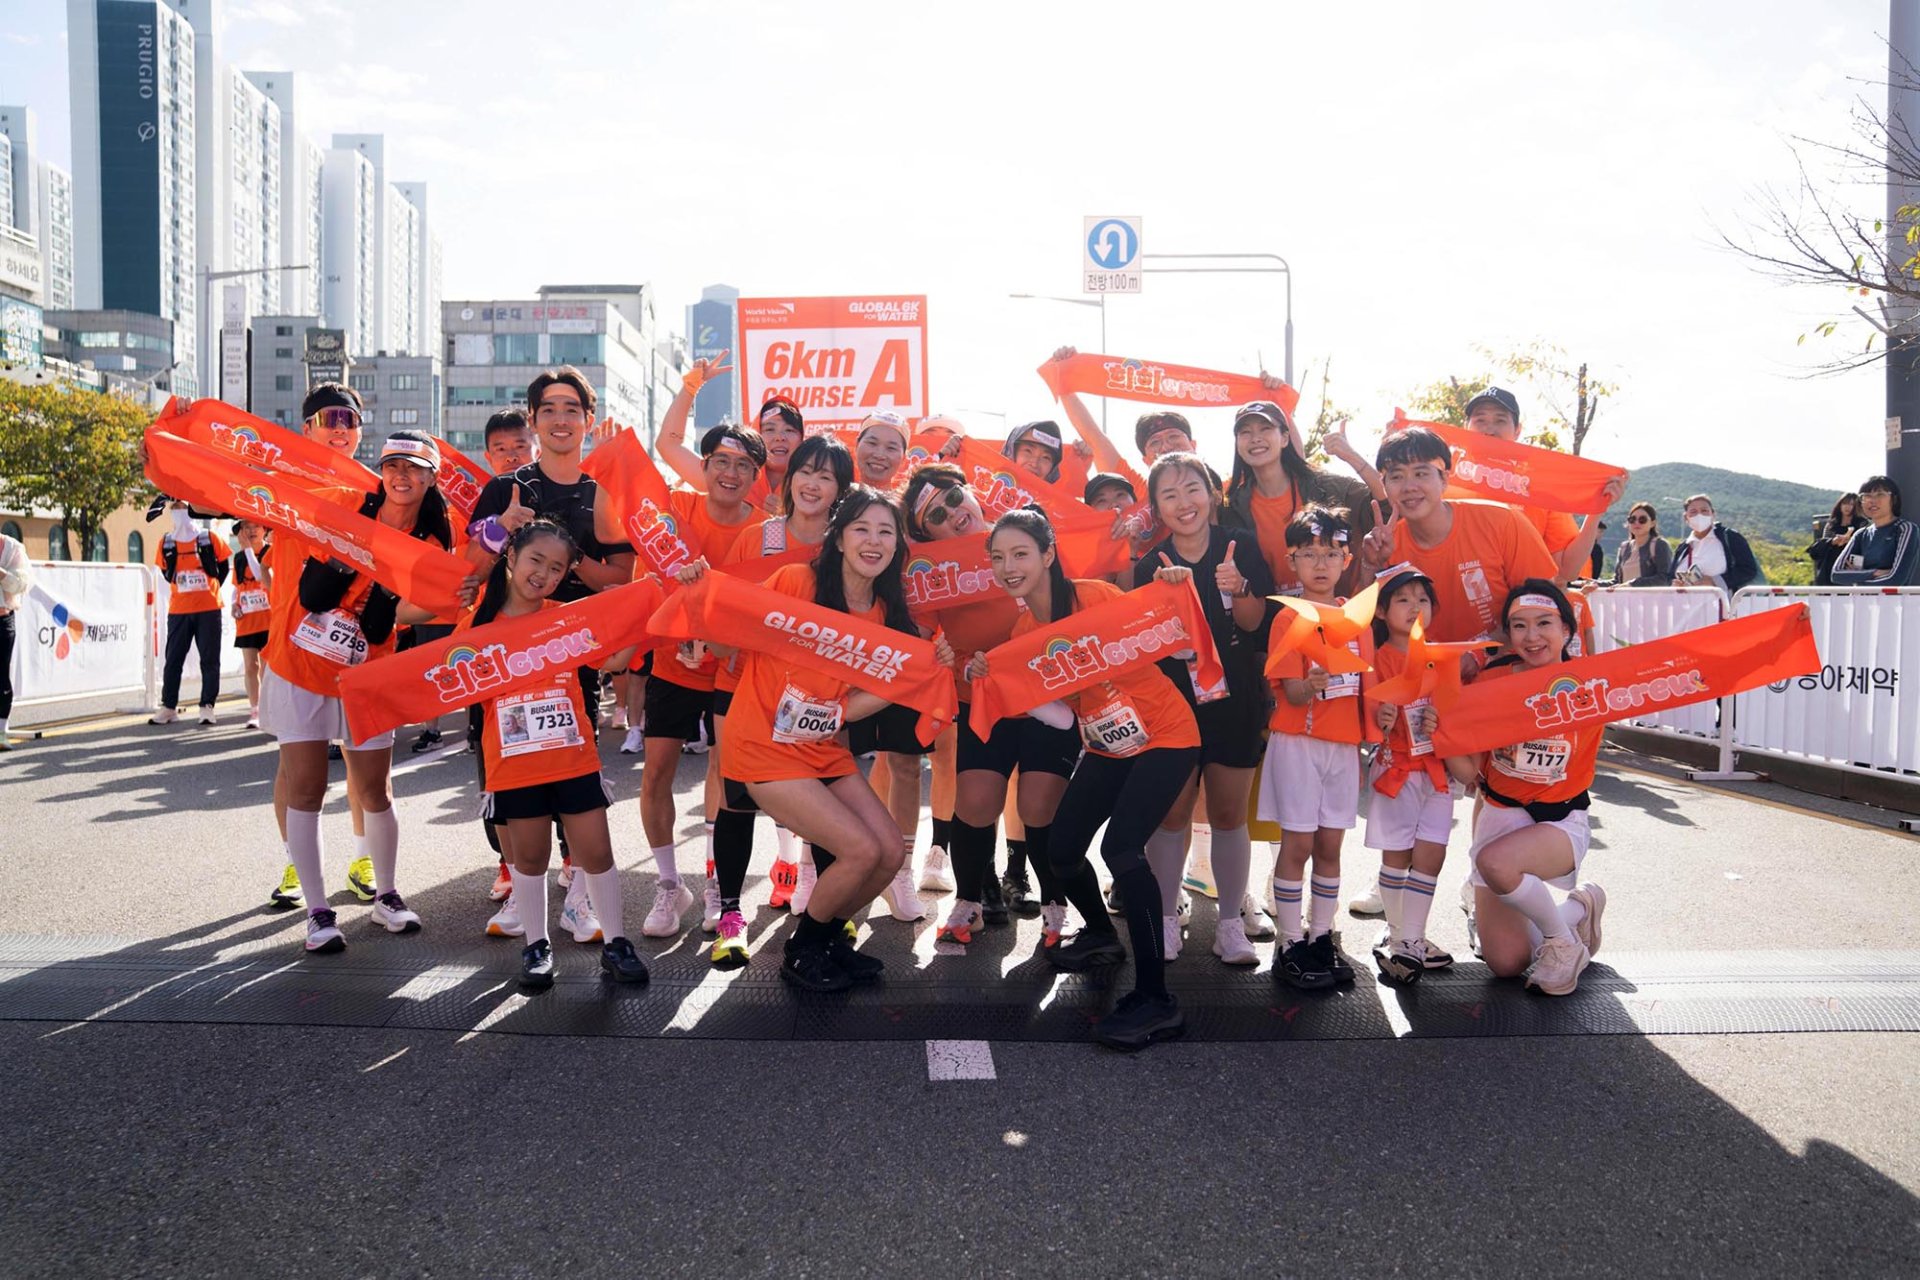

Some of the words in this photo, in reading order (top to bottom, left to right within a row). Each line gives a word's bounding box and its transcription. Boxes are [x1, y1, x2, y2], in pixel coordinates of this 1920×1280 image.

[138, 24, 153, 99] PRUGIO
[1087, 274, 1107, 291] 전방
[767, 307, 788, 315] Vision
[849, 301, 899, 313] GLOBAL
[901, 301, 920, 312] 6K
[878, 312, 918, 321] WATER
[763, 340, 856, 379] 6km
[859, 339, 912, 407] A
[38, 626, 56, 648] CJ
[85, 623, 128, 642] 제일제당
[763, 610, 868, 657] GLOBAL
[871, 645, 912, 671] 6K
[789, 636, 815, 649] FOR
[815, 643, 897, 683] WATER
[530, 703, 556, 715] BUSAN
[804, 708, 828, 718] BUSAN
[536, 712, 574, 730] 7323
[798, 716, 836, 732] 0004
[1103, 721, 1139, 744] 0003
[1522, 742, 1548, 752] BUSAN
[1526, 751, 1565, 767] 7177
